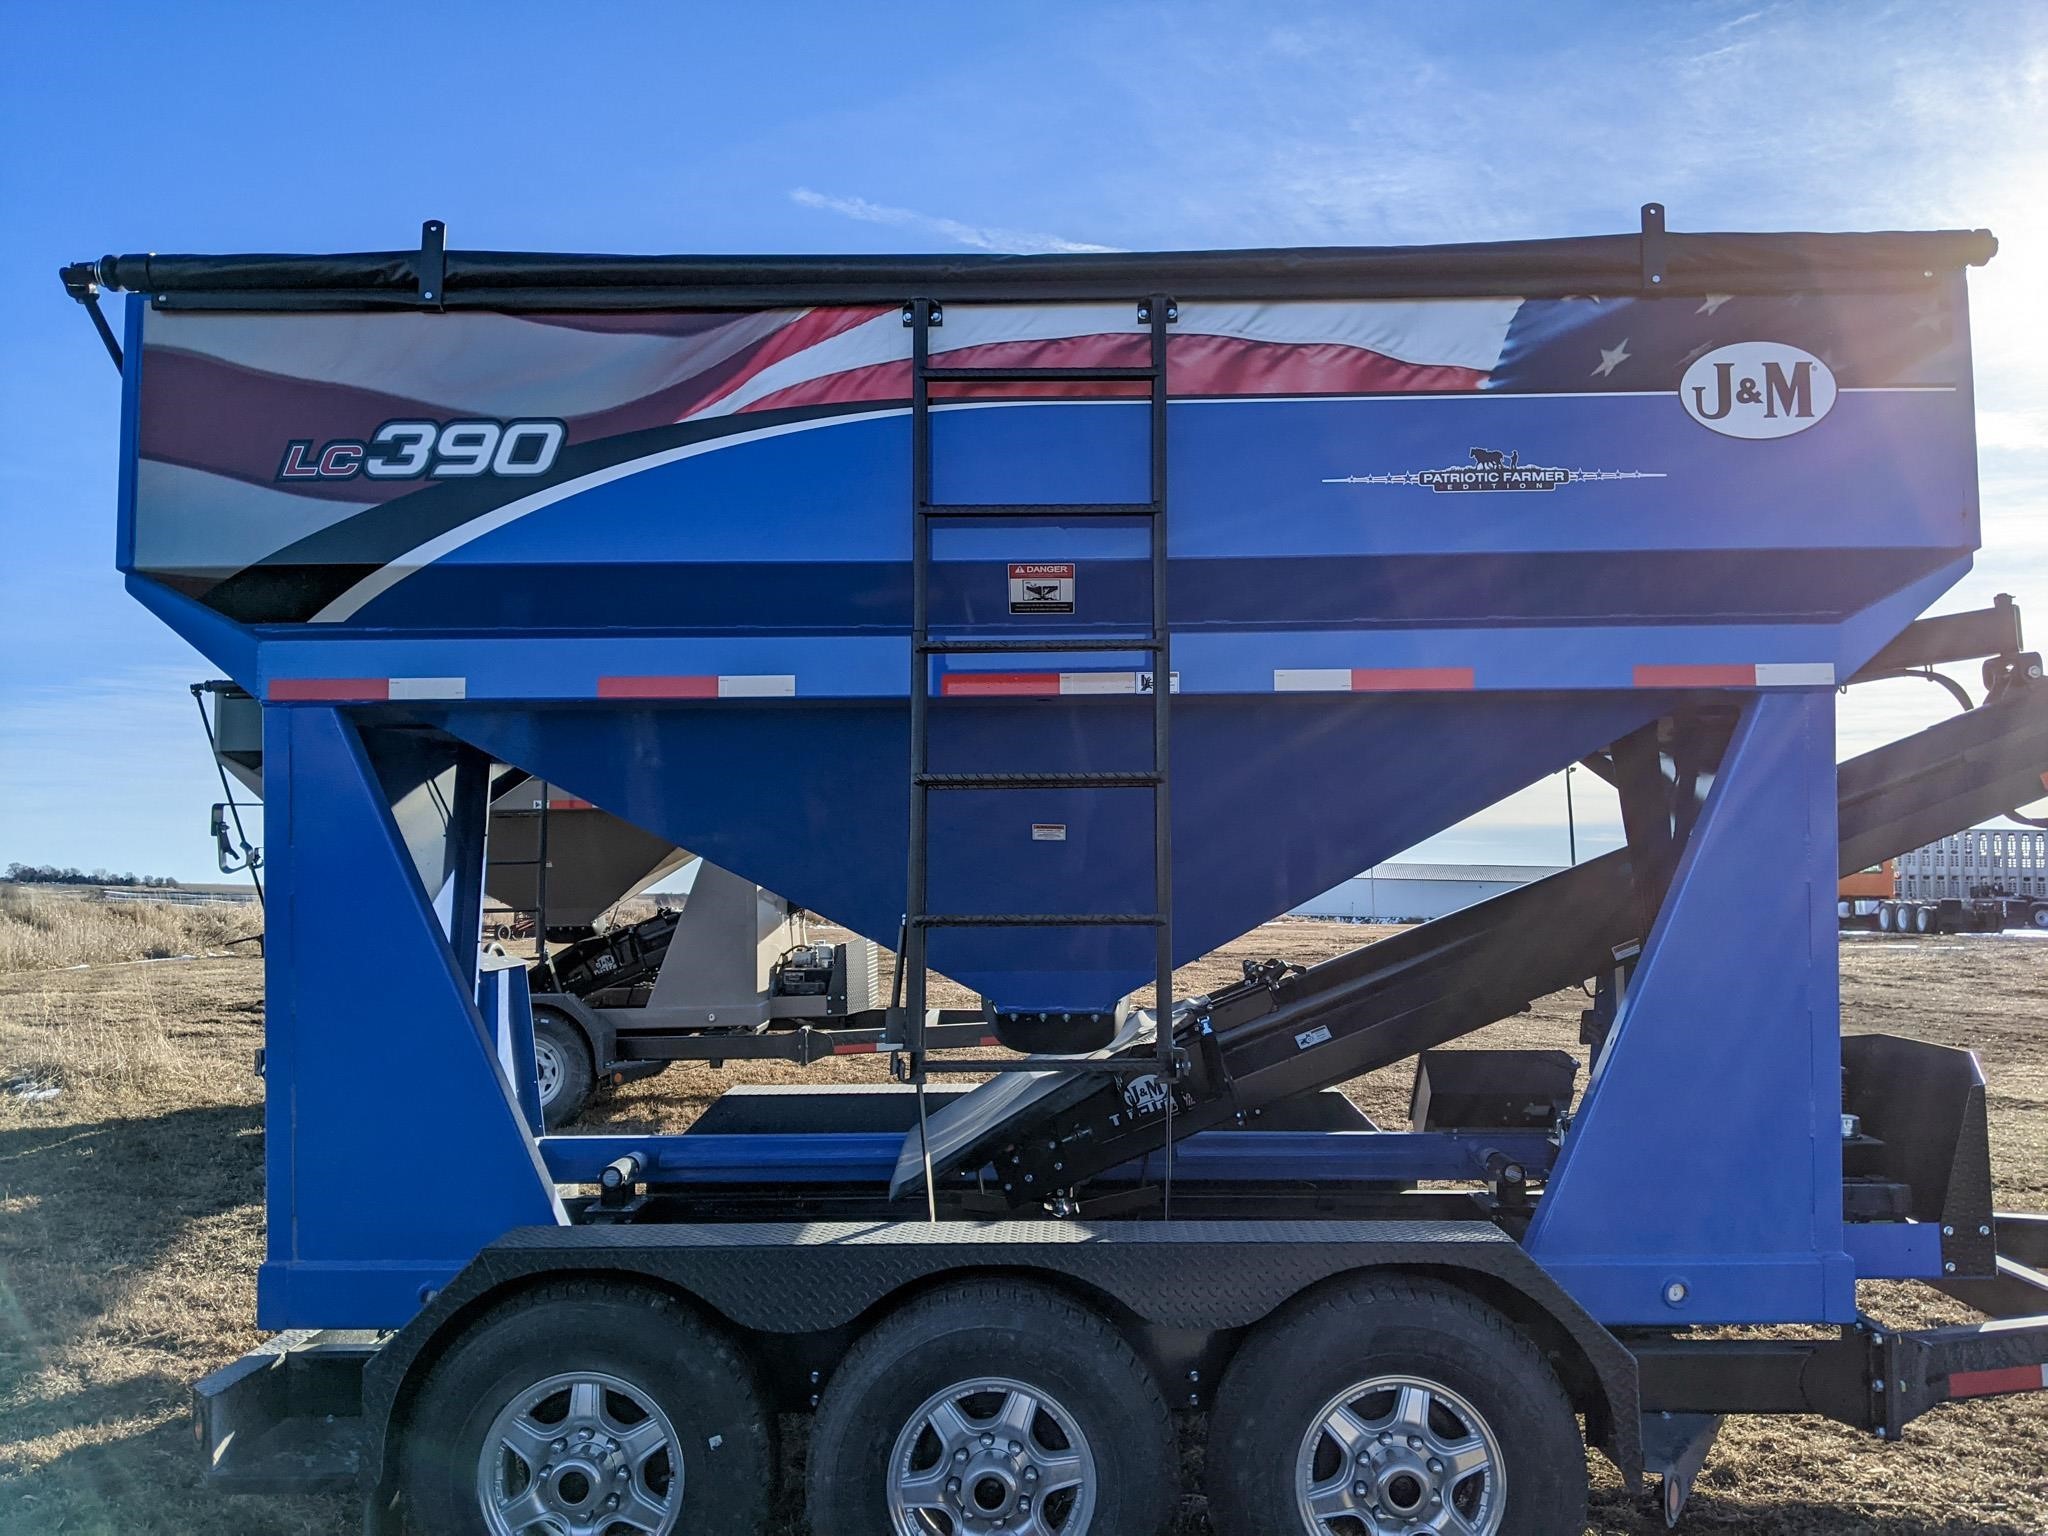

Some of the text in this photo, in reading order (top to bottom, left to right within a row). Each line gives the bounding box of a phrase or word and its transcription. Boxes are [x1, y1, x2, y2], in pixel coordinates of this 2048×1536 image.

[1691, 361, 1815, 420] J&M
[1423, 471, 1565, 483] PATRIOTIC FARMER
[1026, 565, 1068, 573] DANGER
[1126, 1079, 1164, 1105] J&M
